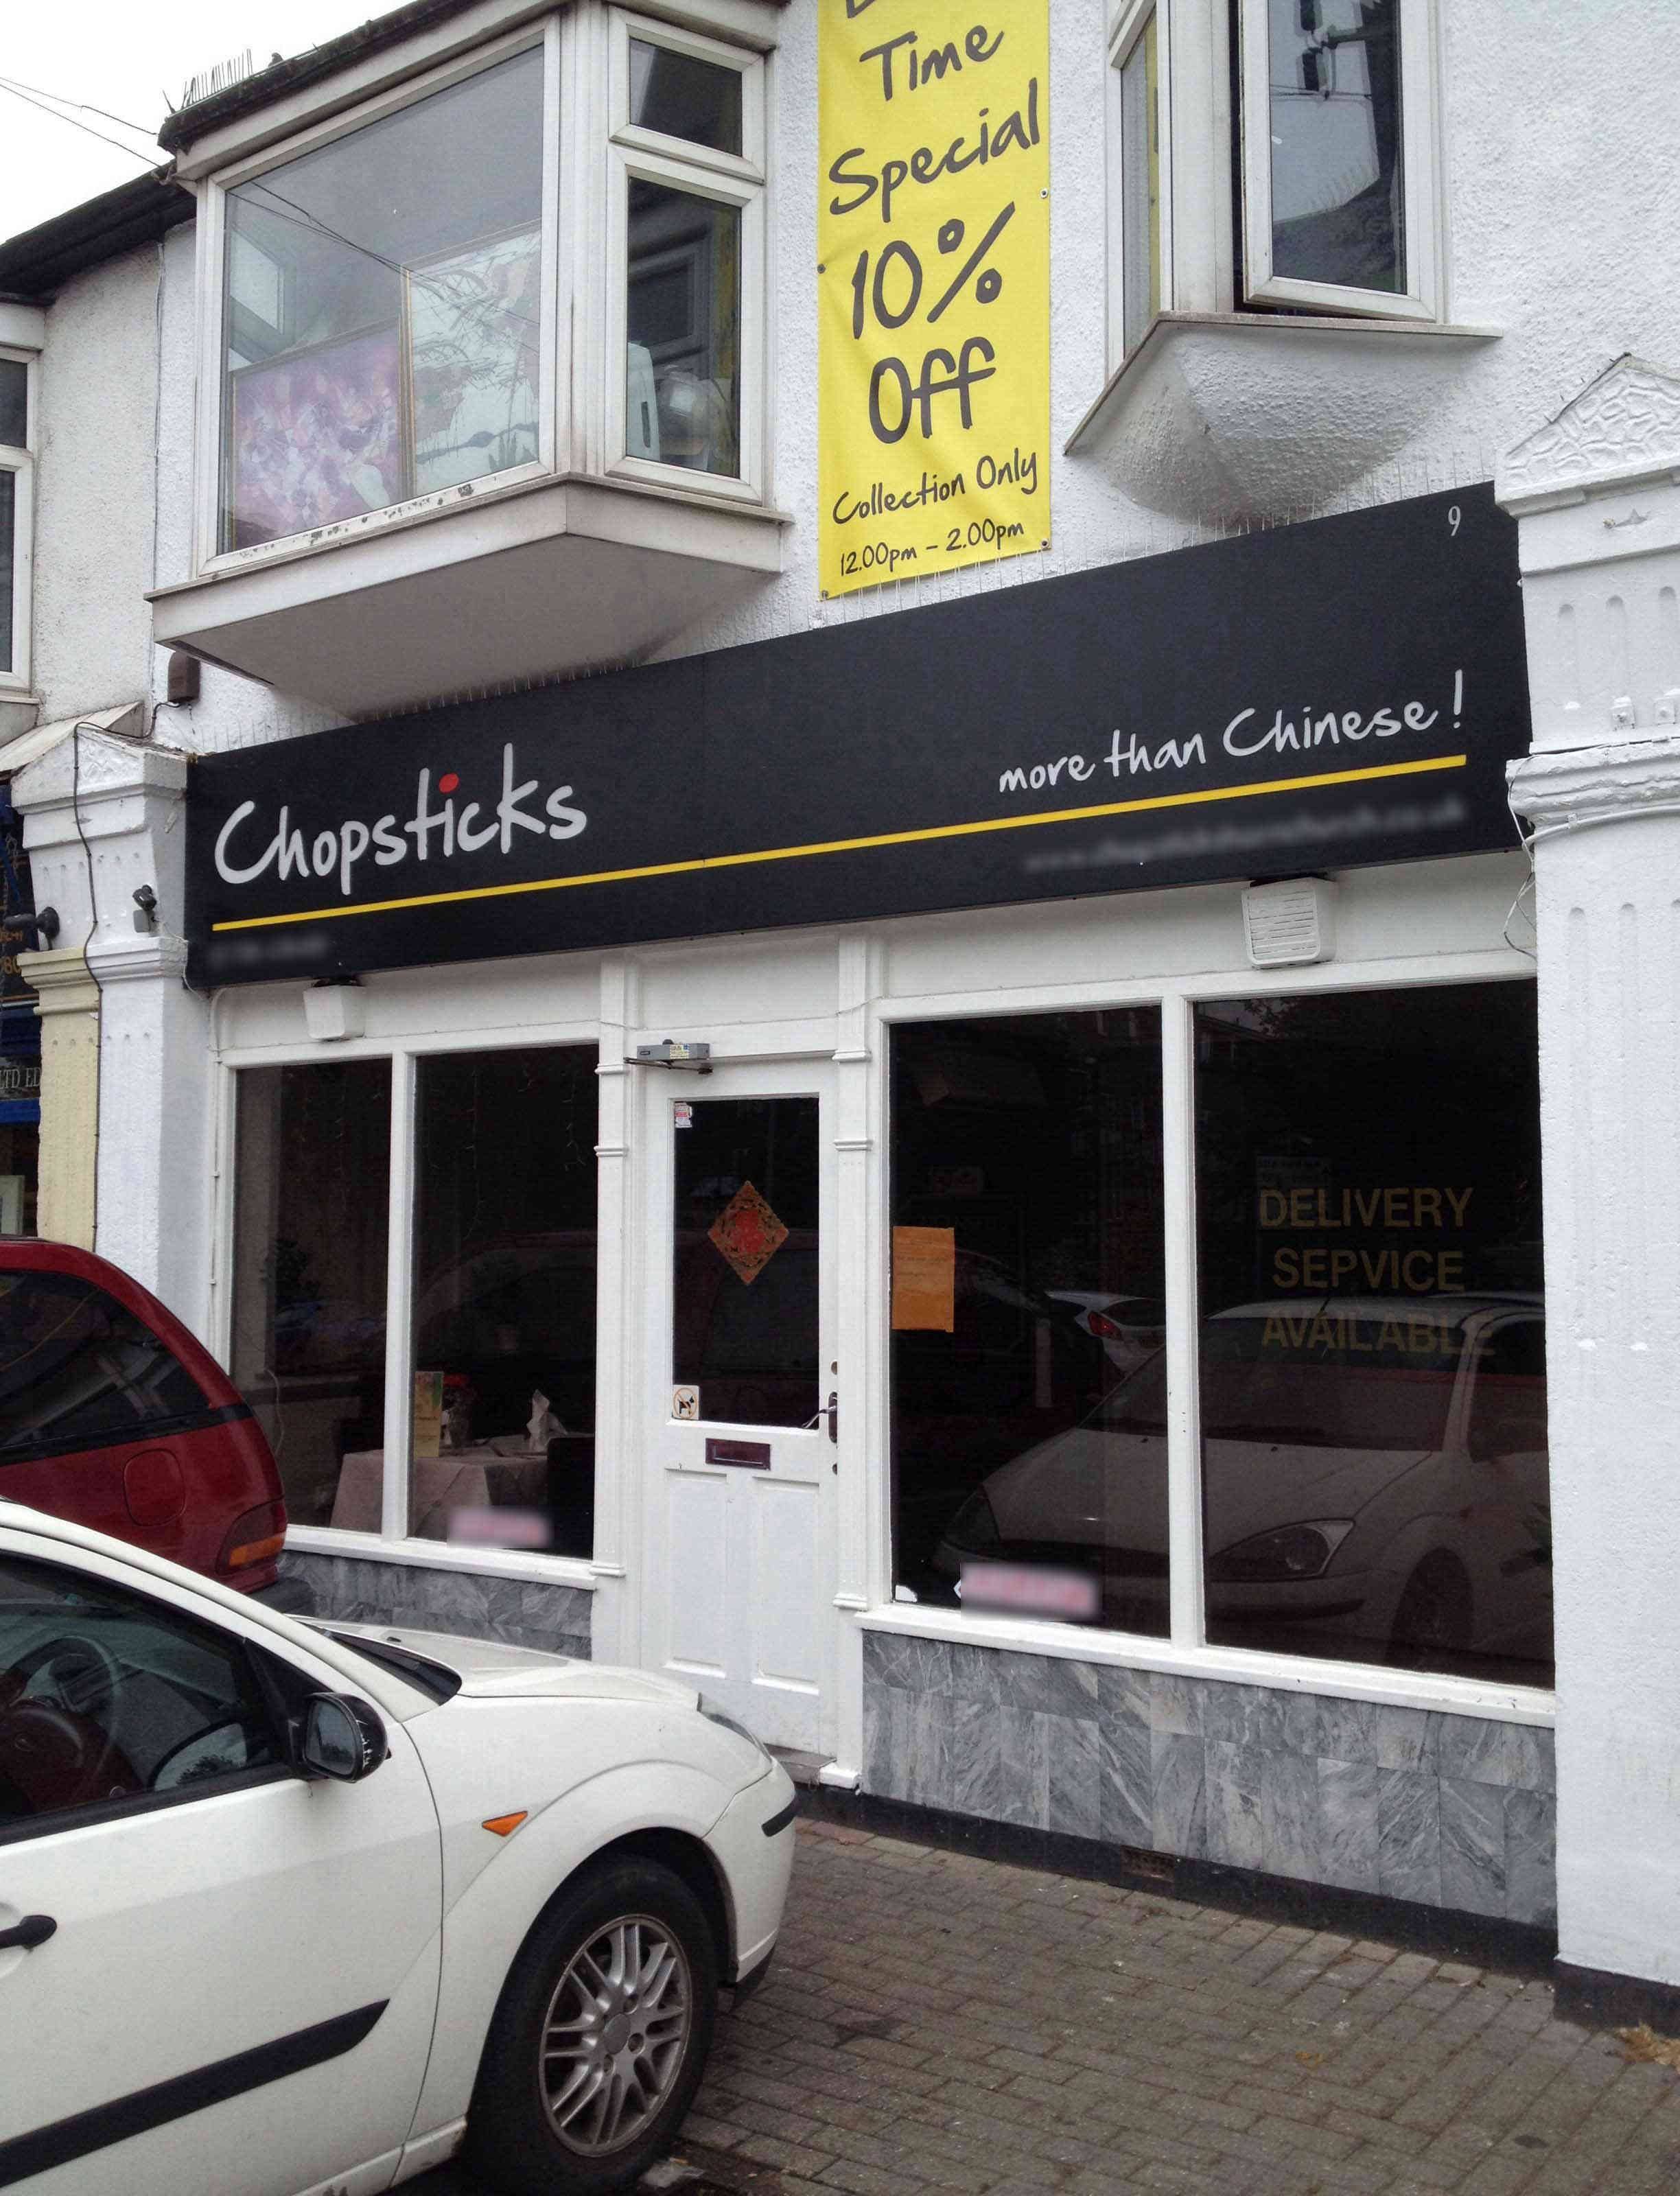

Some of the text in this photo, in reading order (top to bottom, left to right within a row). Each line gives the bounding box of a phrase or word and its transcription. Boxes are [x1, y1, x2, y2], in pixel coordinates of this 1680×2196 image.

[859, 25, 1004, 101] Time
[829, 78, 1040, 223] Special
[852, 202, 1015, 340] 10%
[870, 337, 996, 445] Off
[833, 448, 1038, 524] Collection Only
[1449, 506, 1461, 536] 9
[841, 542, 918, 577] 12.00pm
[946, 519, 1025, 553] 2.00pm
[999, 755, 1096, 793] more
[1103, 729, 1206, 778] than
[215, 743, 587, 895] Chopsticks
[1258, 1187, 1473, 1229] DELIVERY
